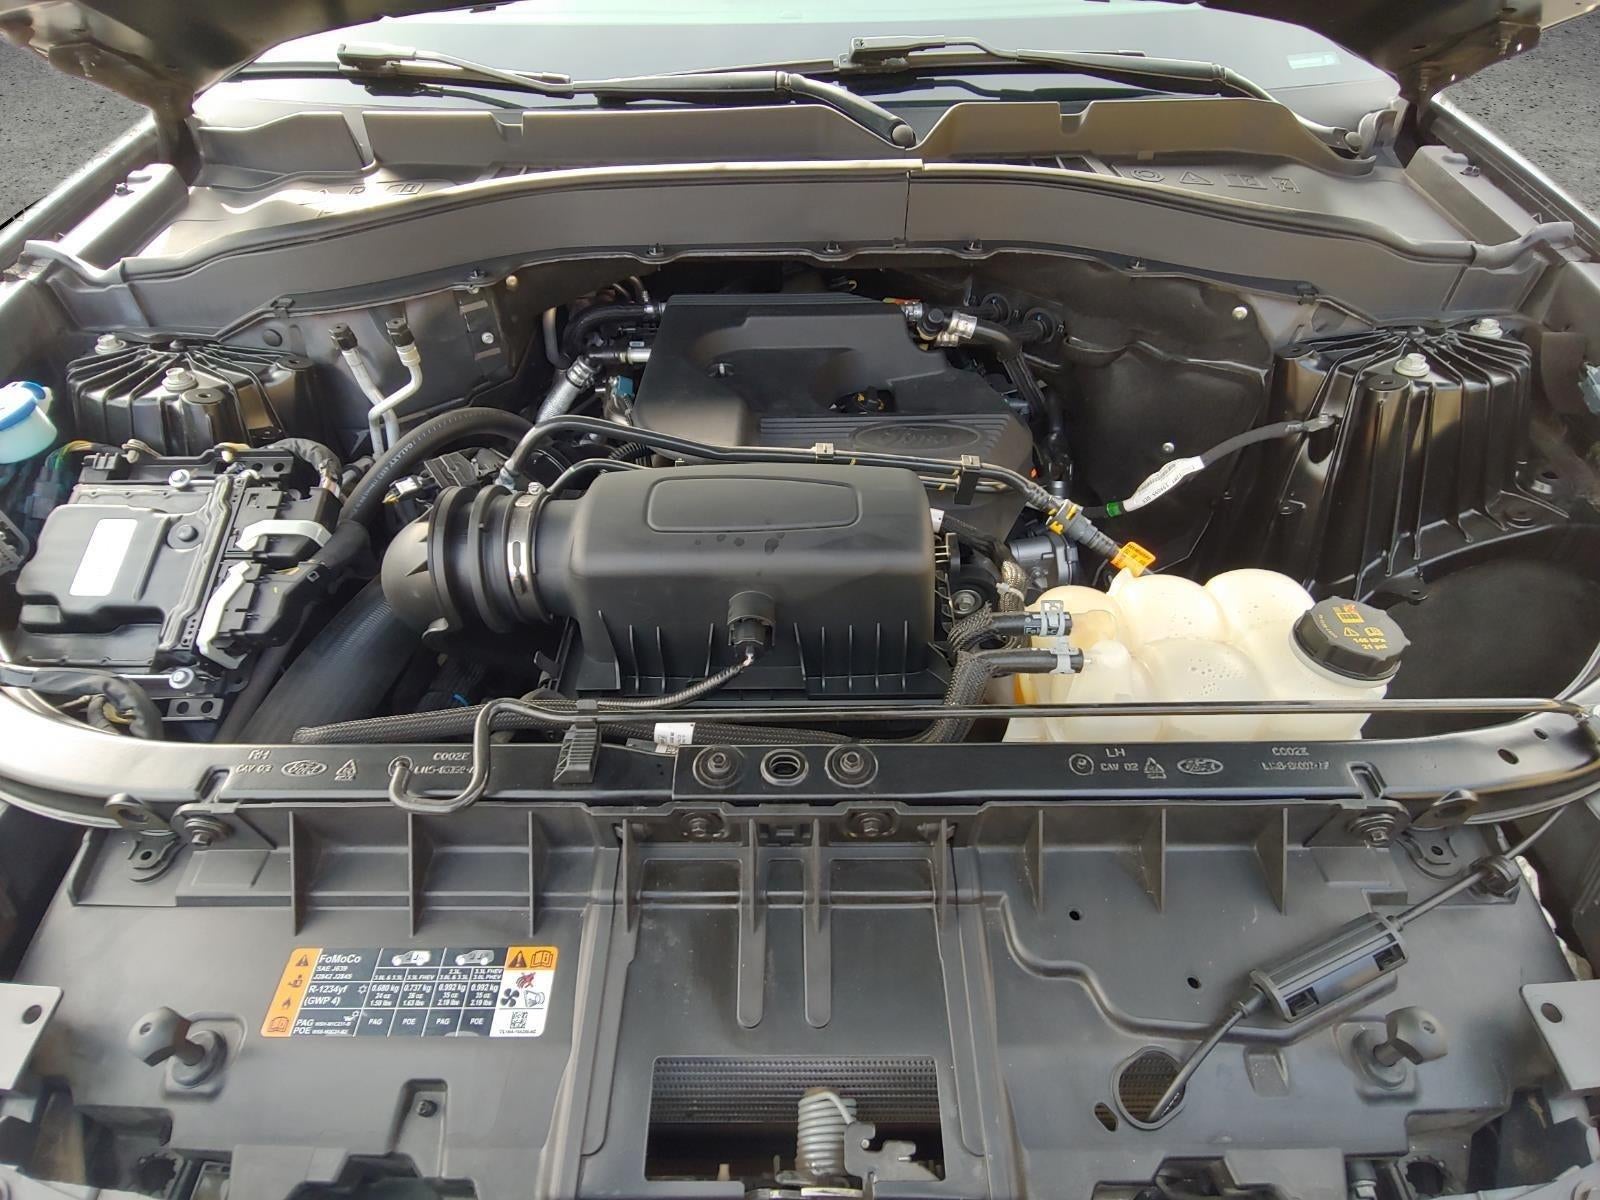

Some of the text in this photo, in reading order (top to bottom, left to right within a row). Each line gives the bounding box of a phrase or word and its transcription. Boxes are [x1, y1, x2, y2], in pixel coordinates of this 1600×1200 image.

[1105, 748, 1126, 757] LH
[319, 954, 361, 964] FoMoCo
[308, 984, 348, 995] R-1234yf
[390, 984, 400, 993] kg
[403, 983, 432, 993] 0.737 kg
[457, 983, 467, 993] kg
[489, 983, 499, 993] kg
[304, 996, 341, 1006] (GWP 4)
[295, 1019, 315, 1027] PAG
[293, 1026, 312, 1035] POE
